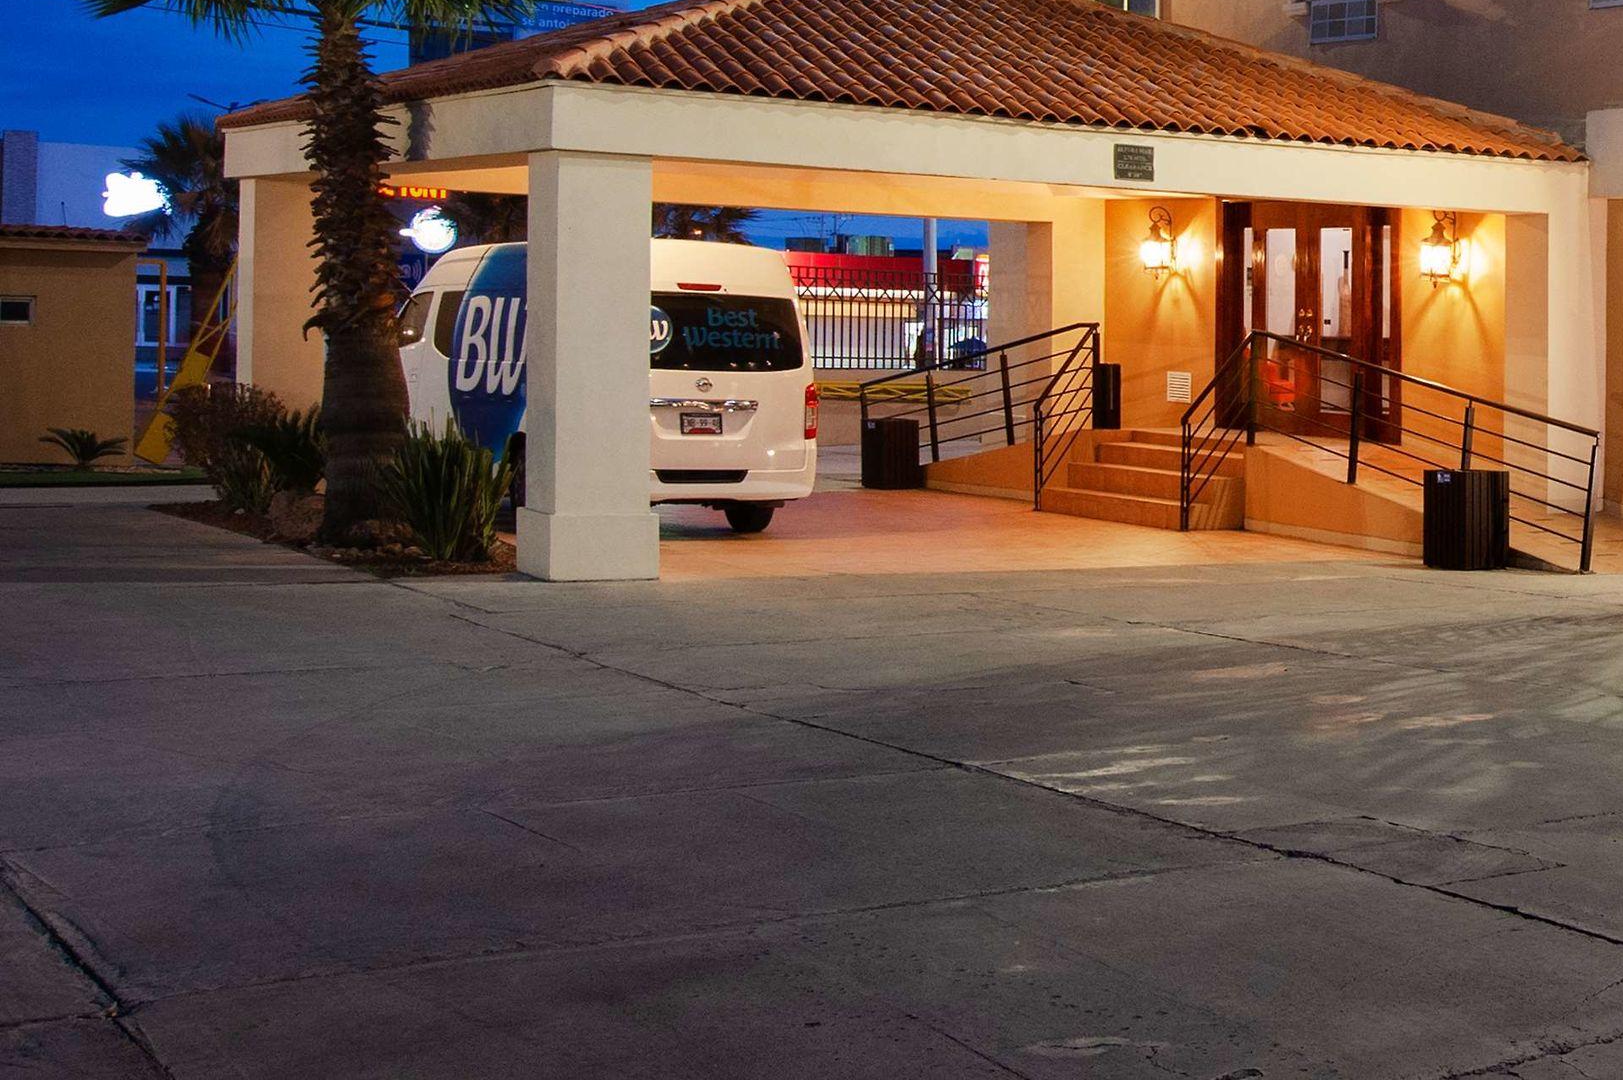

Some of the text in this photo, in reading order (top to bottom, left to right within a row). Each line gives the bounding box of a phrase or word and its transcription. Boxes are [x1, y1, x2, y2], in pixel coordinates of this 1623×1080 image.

[706, 307, 760, 328] Best
[456, 295, 528, 395] BW
[682, 325, 781, 350] Western
